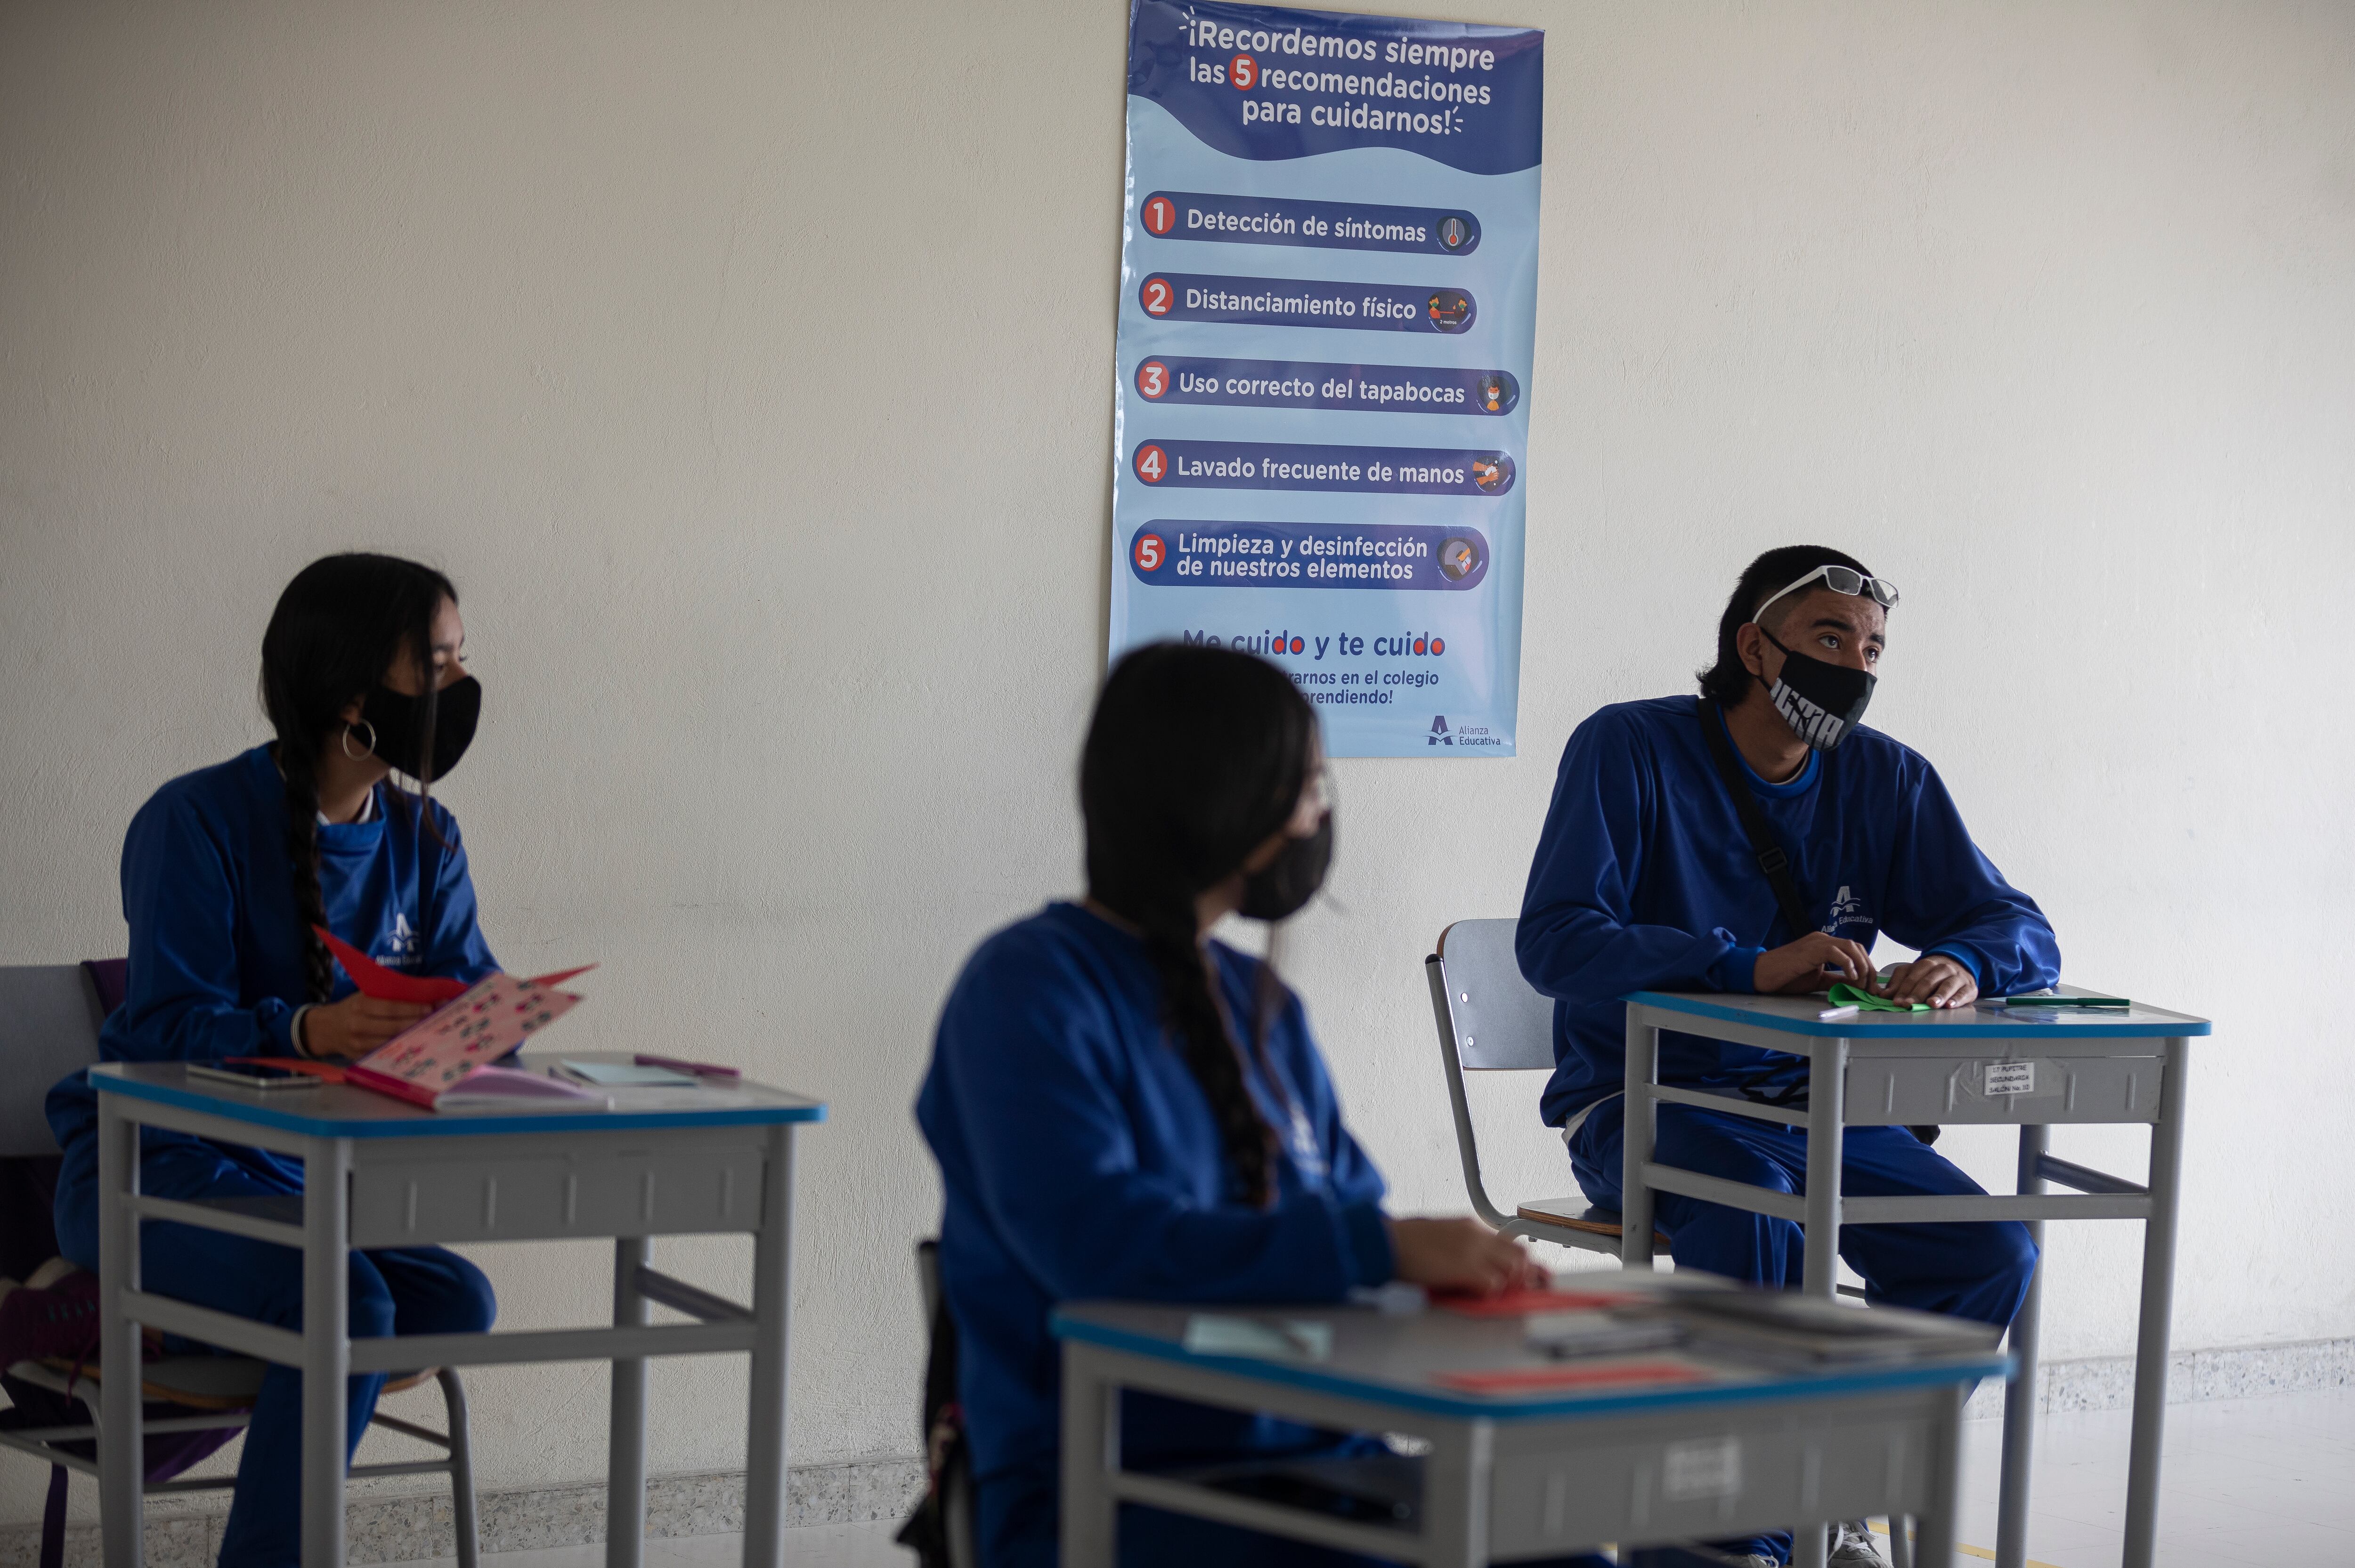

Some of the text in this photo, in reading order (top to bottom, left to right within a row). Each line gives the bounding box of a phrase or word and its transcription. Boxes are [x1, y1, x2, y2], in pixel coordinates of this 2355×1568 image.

[1189, 20, 1494, 73] ¡Recordemos siempre
[1191, 57, 1492, 105] las 5 recomendaciones
[1243, 100, 1451, 135] para cuidarnos!
[1153, 202, 1426, 242] 1 Detección de síntomas
[1148, 283, 1416, 319] 2 Distanciamiento físico
[1144, 367, 1465, 404] 3 Uso correcto del tapabocas
[1141, 450, 1464, 484] 4 Lavado frecuente de manos
[1140, 533, 1427, 568] 5 Limpieza y desinfección
[1177, 557, 1413, 579] de nuestros elementos
[1184, 630, 1445, 661] Me cuido y te cuido
[1341, 673, 1359, 685] en
[1364, 670, 1378, 685] el
[1383, 670, 1439, 688] colegio
[1459, 726, 1489, 735] Alianza
[1460, 736, 1501, 745] Educativa
[1838, 916, 1873, 924] Educativa
